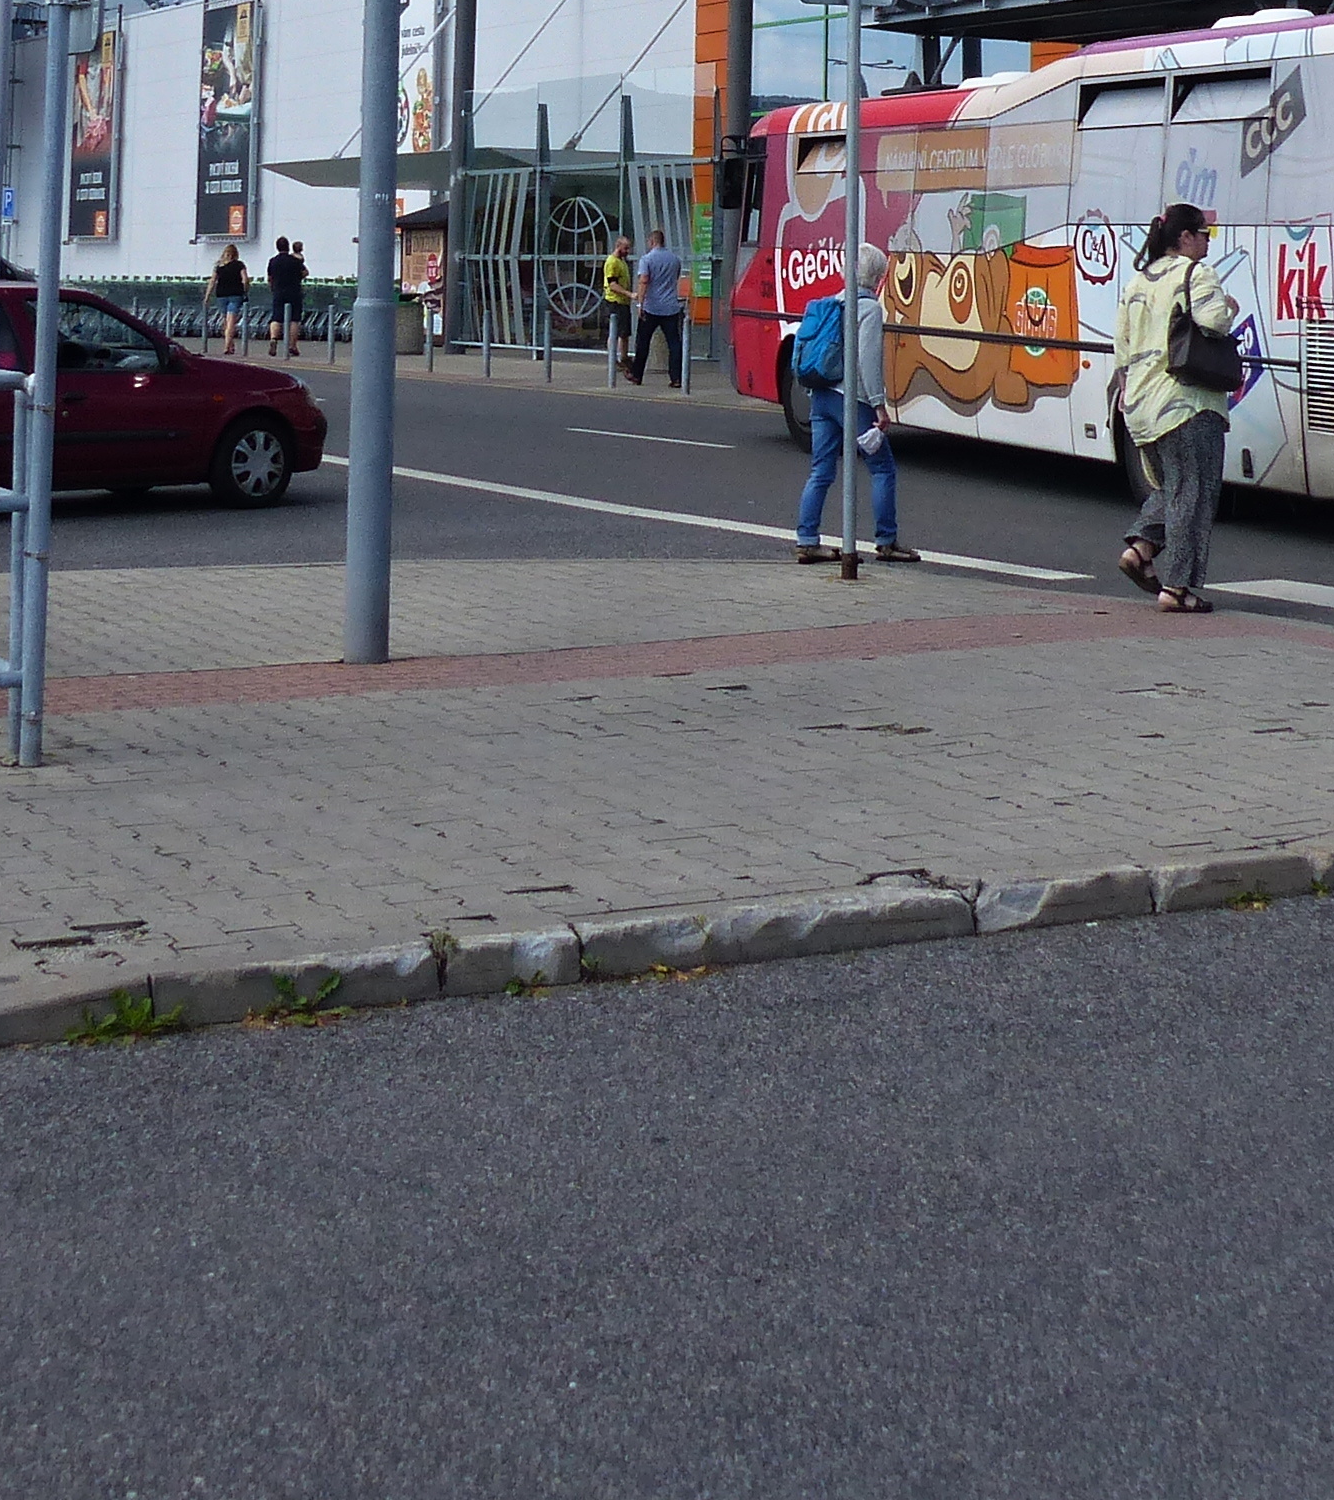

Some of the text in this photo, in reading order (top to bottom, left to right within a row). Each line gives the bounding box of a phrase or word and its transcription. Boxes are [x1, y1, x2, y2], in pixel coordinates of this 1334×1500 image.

[787, 237, 847, 290] Géčk
[1082, 229, 1110, 269] C&A
[1276, 240, 1328, 321] kik
